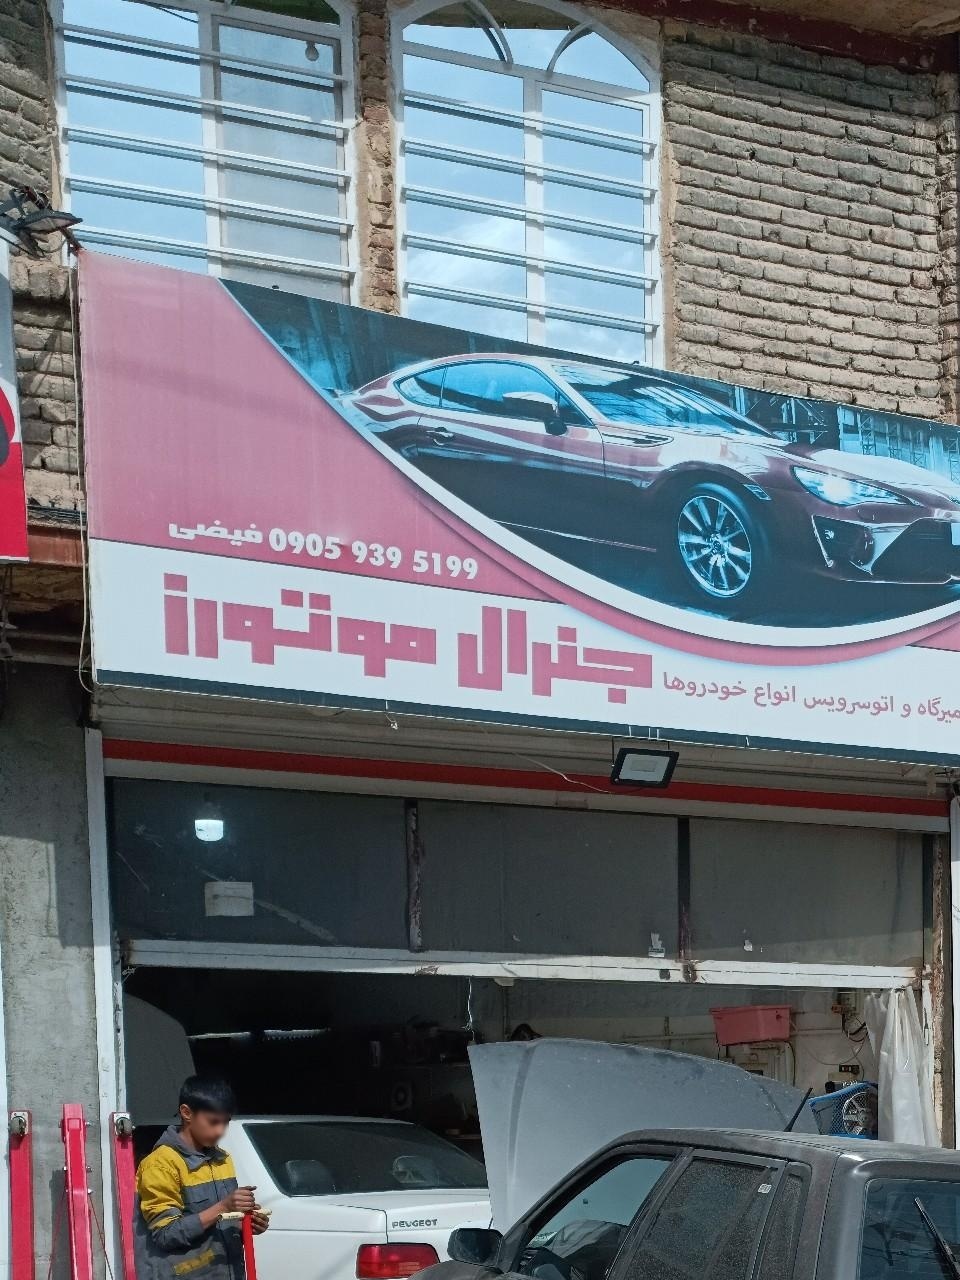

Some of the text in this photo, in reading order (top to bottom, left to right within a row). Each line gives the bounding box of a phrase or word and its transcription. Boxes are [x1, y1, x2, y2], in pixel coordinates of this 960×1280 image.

[168, 519, 478, 579] 0905 939 5199 فیضی
[163, 572, 653, 704] جنرال موتورز
[662, 671, 747, 700] خودروها
[753, 683, 796, 707] انواع
[803, 696, 894, 715] اتوسرویس
[900, 704, 911, 718] و
[392, 1218, 438, 1228] PEUGEOT
